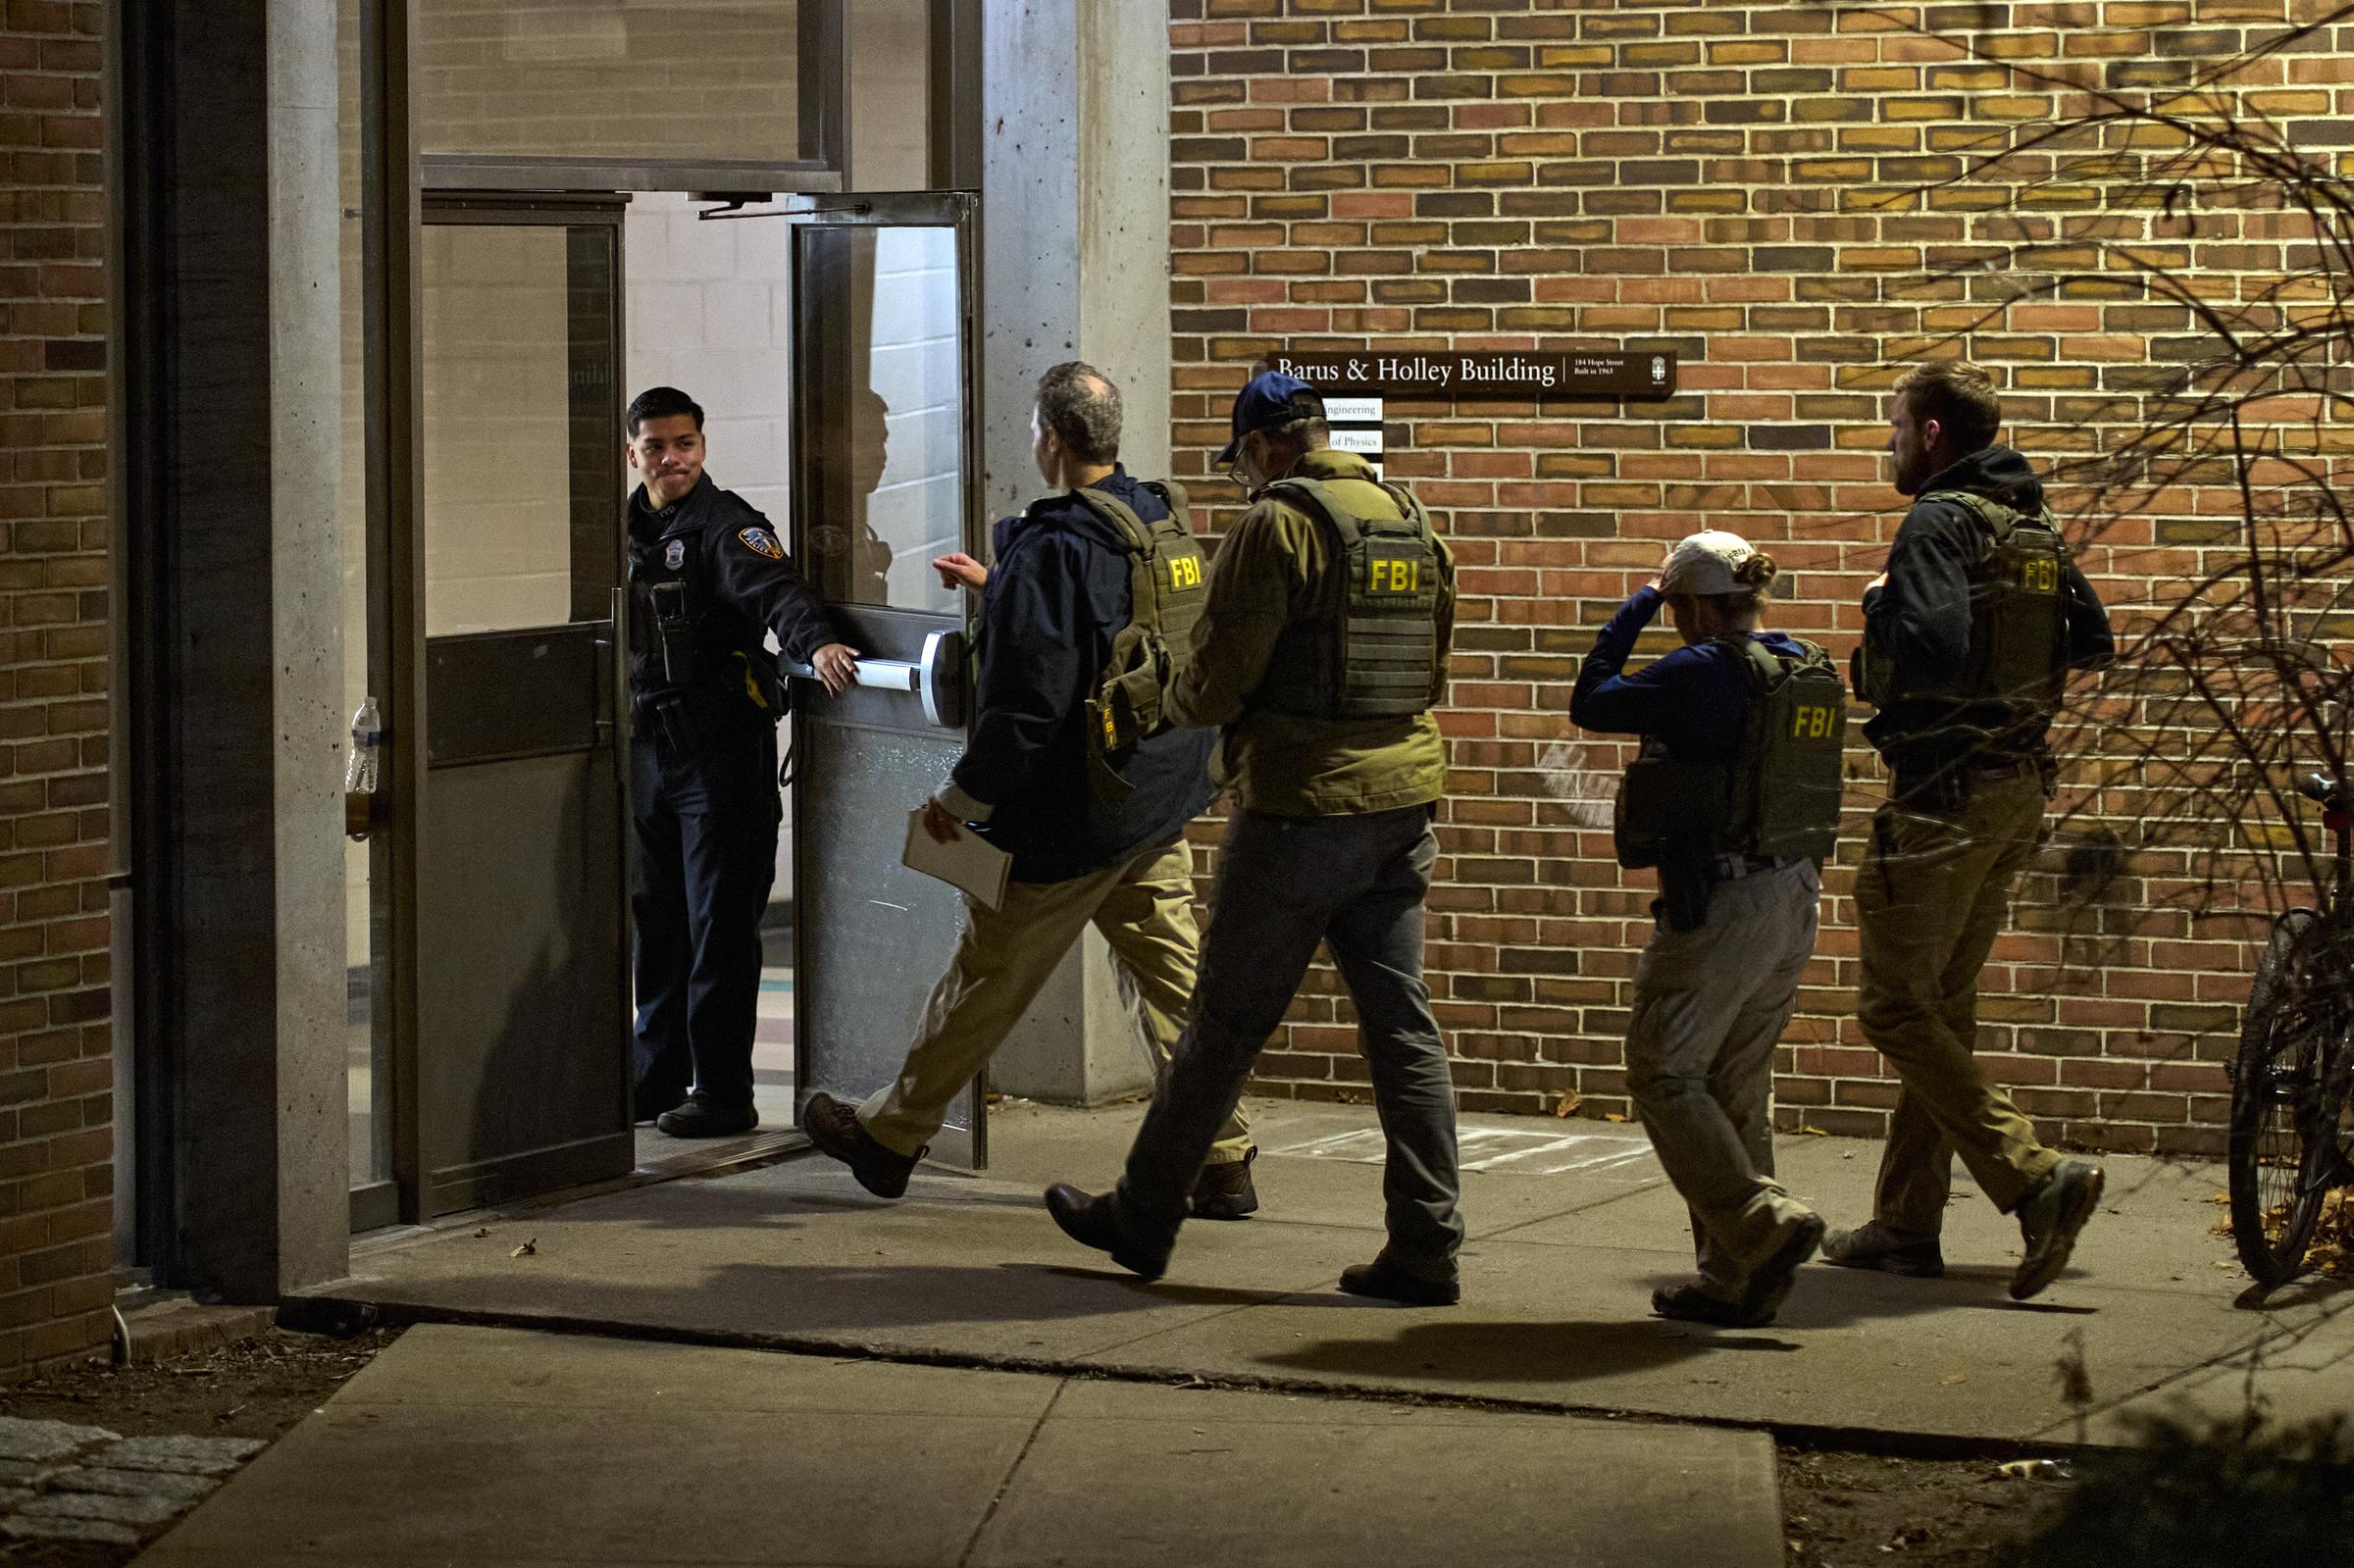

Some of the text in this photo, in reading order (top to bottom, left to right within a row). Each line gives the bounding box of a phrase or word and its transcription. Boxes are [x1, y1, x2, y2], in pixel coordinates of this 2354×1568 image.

[1278, 357, 1556, 387] Barus & Holley Building
[1574, 358, 1624, 369] 184 Hope Street
[1326, 403, 1376, 416] ngineering
[1331, 436, 1377, 449] of Physics
[1169, 555, 1202, 588] FBI
[1370, 560, 1418, 591] FBI
[2024, 559, 2058, 591] FBI
[1103, 707, 1116, 746] FBI
[1793, 705, 1836, 736] FBI
